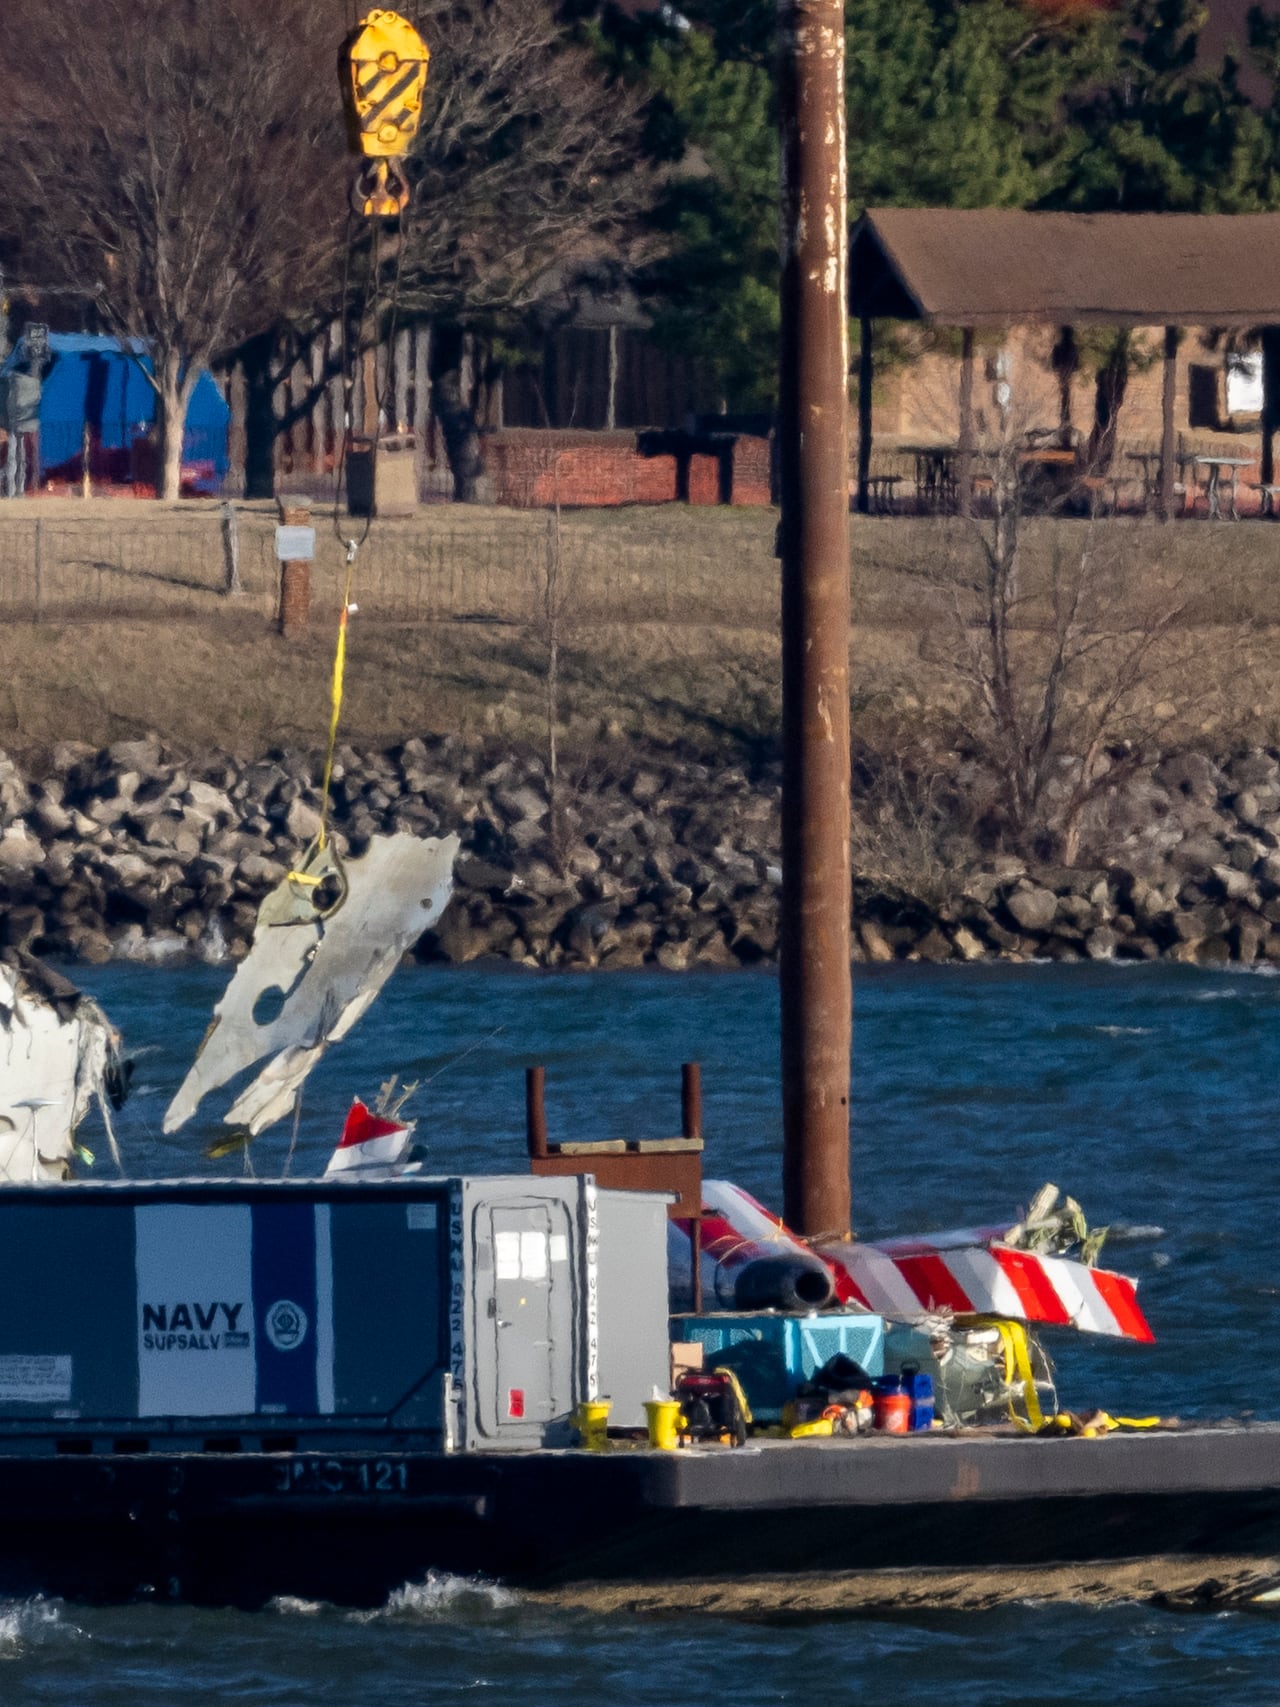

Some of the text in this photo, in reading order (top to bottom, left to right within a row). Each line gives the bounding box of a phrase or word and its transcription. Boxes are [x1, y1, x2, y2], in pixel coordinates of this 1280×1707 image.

[142, 1302, 244, 1331] NAVY
[144, 1333, 220, 1350] SUPSALV
[359, 1460, 408, 1491] 121
